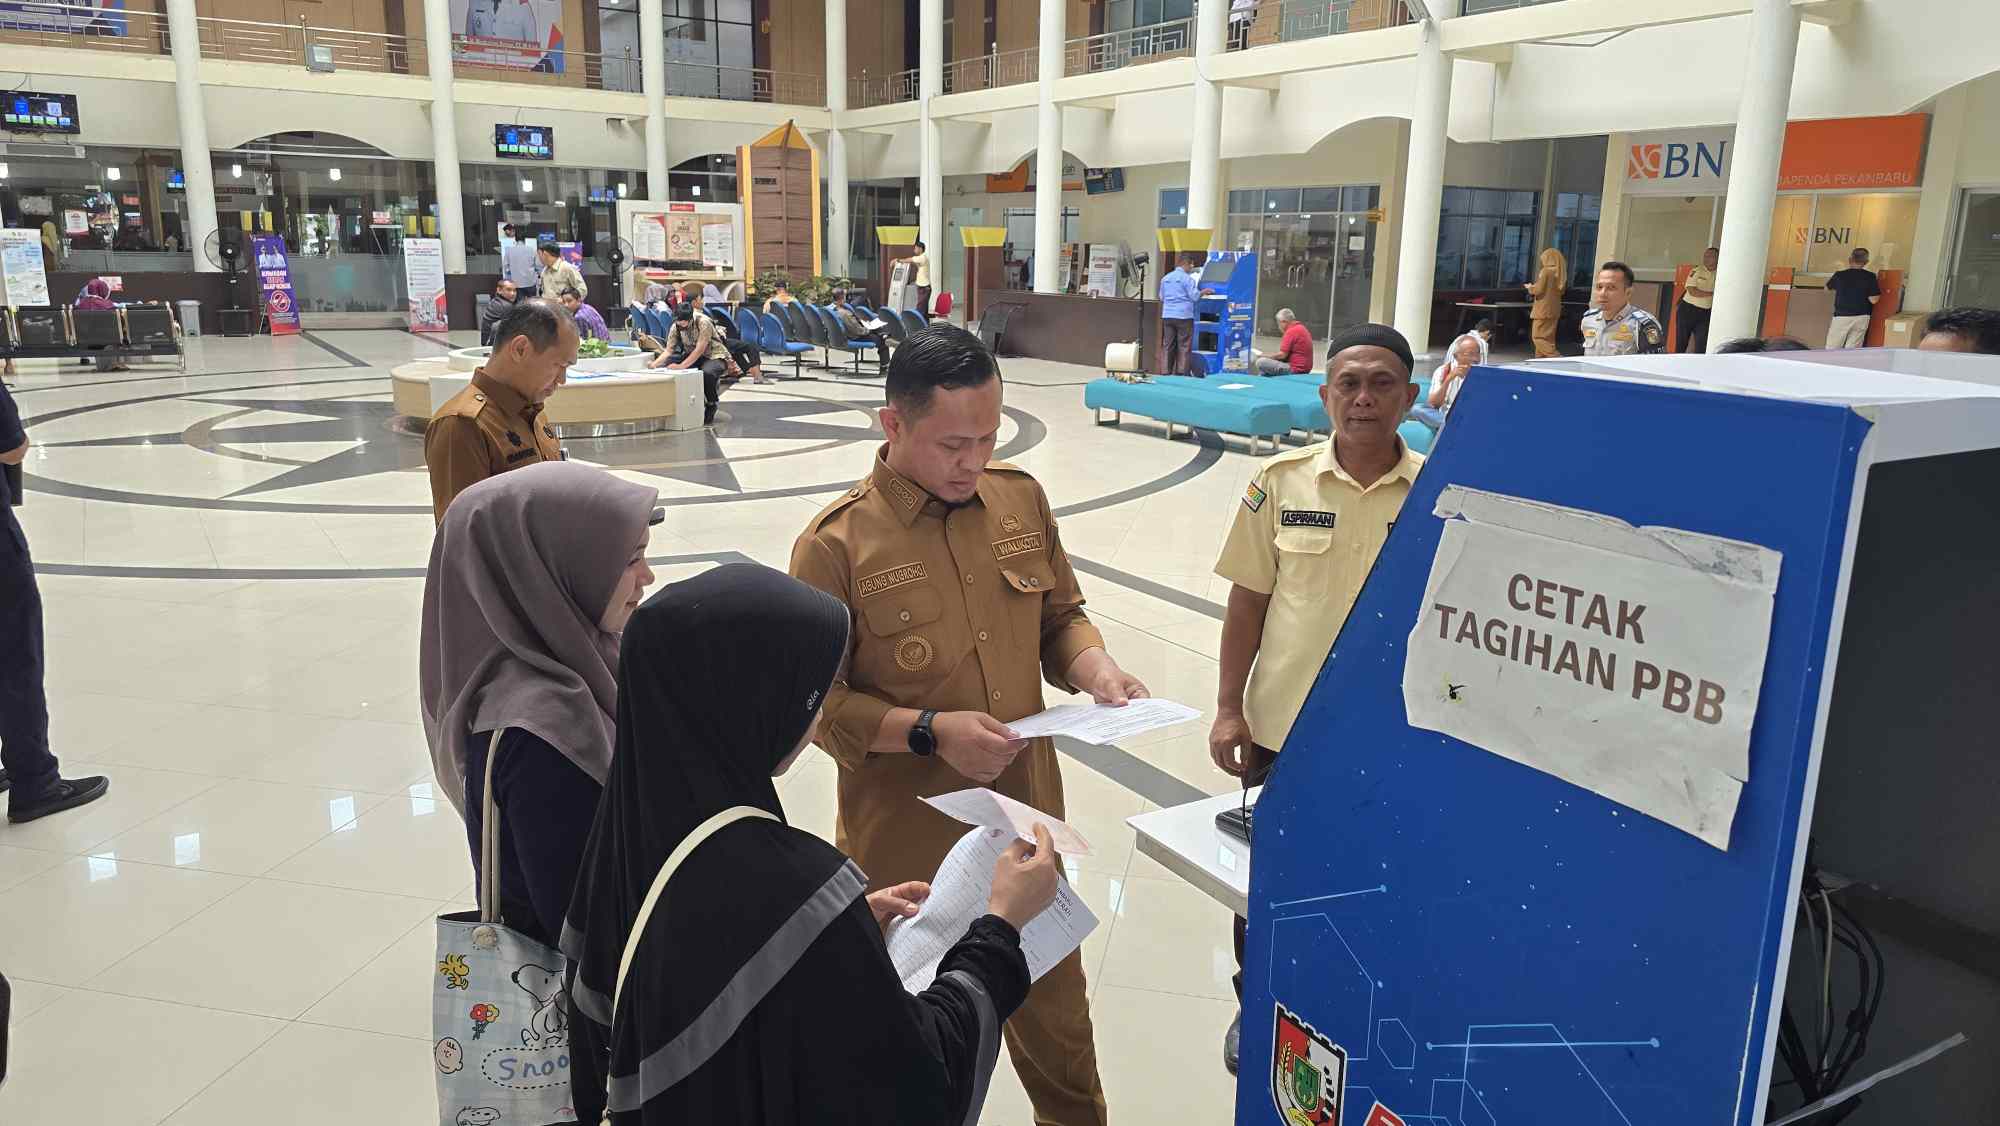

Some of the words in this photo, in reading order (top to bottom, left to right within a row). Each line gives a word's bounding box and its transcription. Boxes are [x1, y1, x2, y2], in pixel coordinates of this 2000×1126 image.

[1663, 140, 1728, 179] BN
[1834, 171, 1912, 185] PEKANBARU
[1814, 226, 1852, 245] BNI
[1284, 512, 1332, 526] ASPIRMAN
[999, 533, 1041, 555] WALIKOTA
[860, 574, 888, 593] AGUNG
[888, 564, 924, 584] NUGROHO
[1507, 573, 1648, 644] CETAK
[1434, 603, 1617, 692] TAGIHAN
[1631, 659, 1727, 725] PBB
[498, 1054, 570, 1082] Snoo
